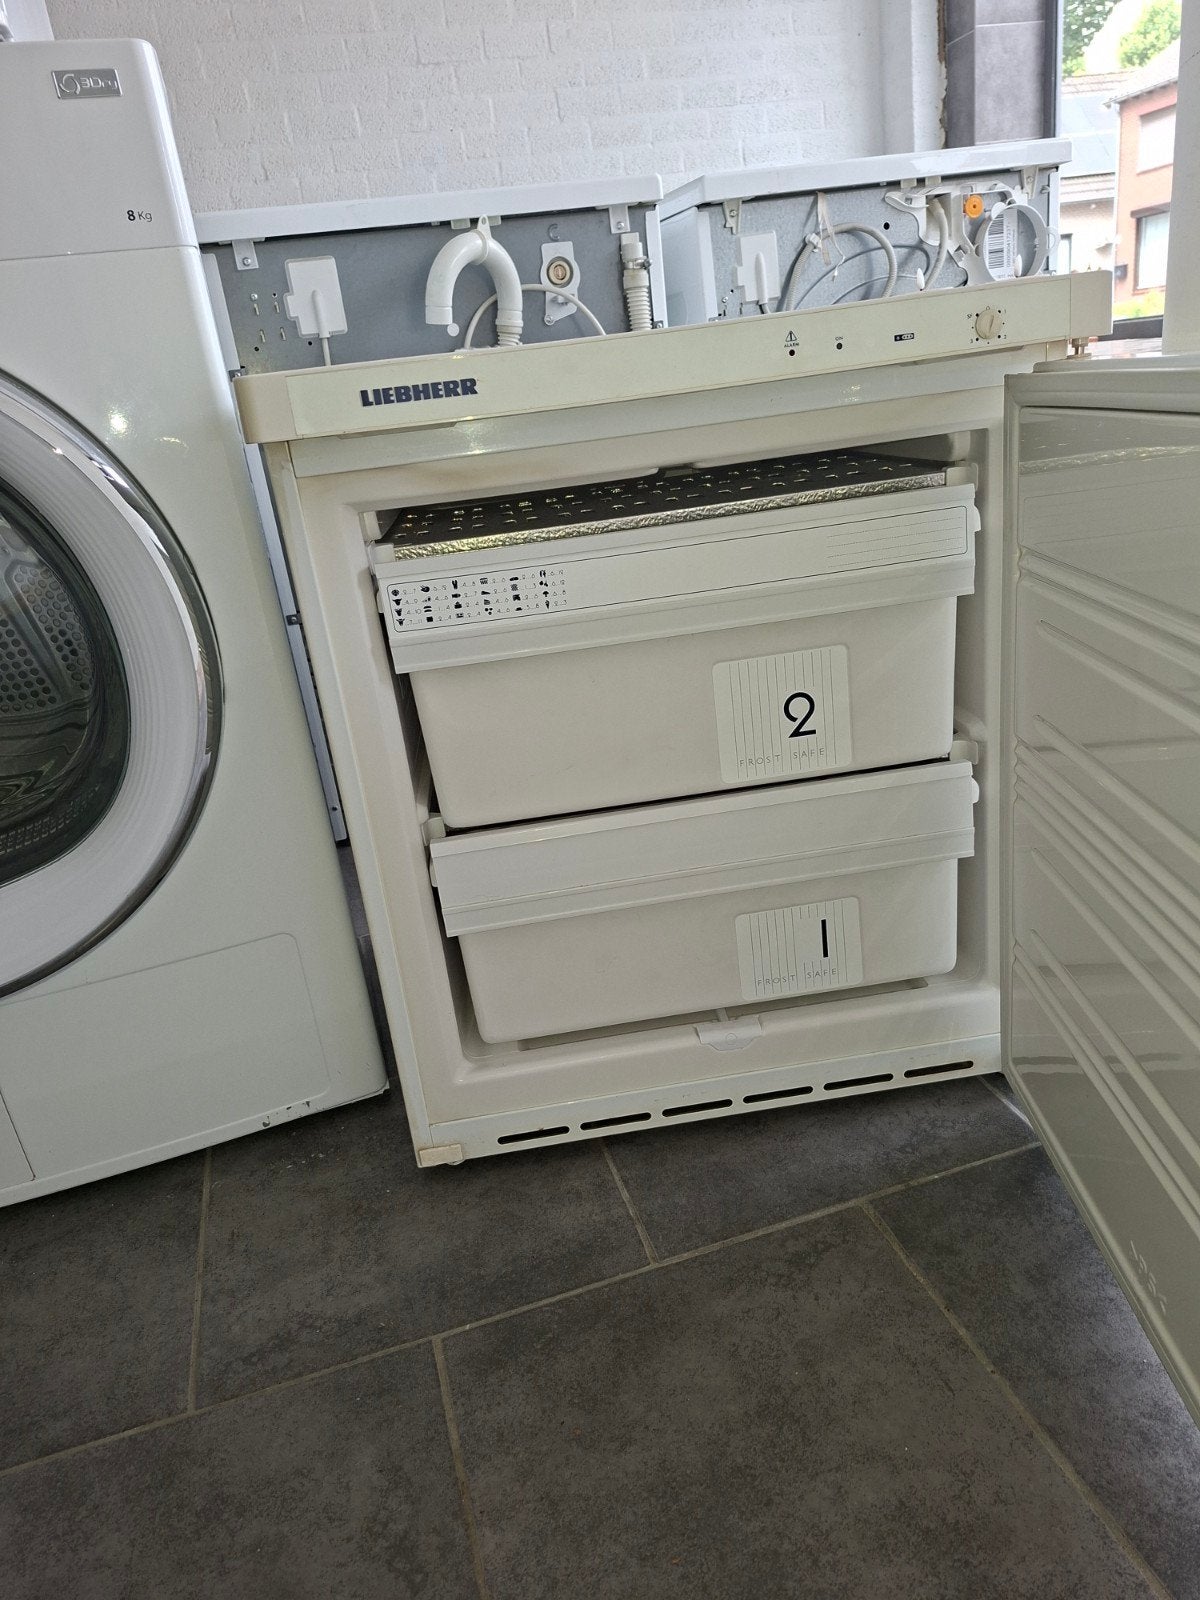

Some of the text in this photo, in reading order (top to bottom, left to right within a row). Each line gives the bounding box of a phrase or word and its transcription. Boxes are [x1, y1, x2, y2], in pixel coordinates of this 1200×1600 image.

[127, 210, 153, 222] 8 Kg
[360, 378, 478, 407] LIEBHERR
[783, 692, 816, 738] 2
[738, 748, 825, 768] FROST SAFE
[757, 967, 837, 986] FROST SAFE
